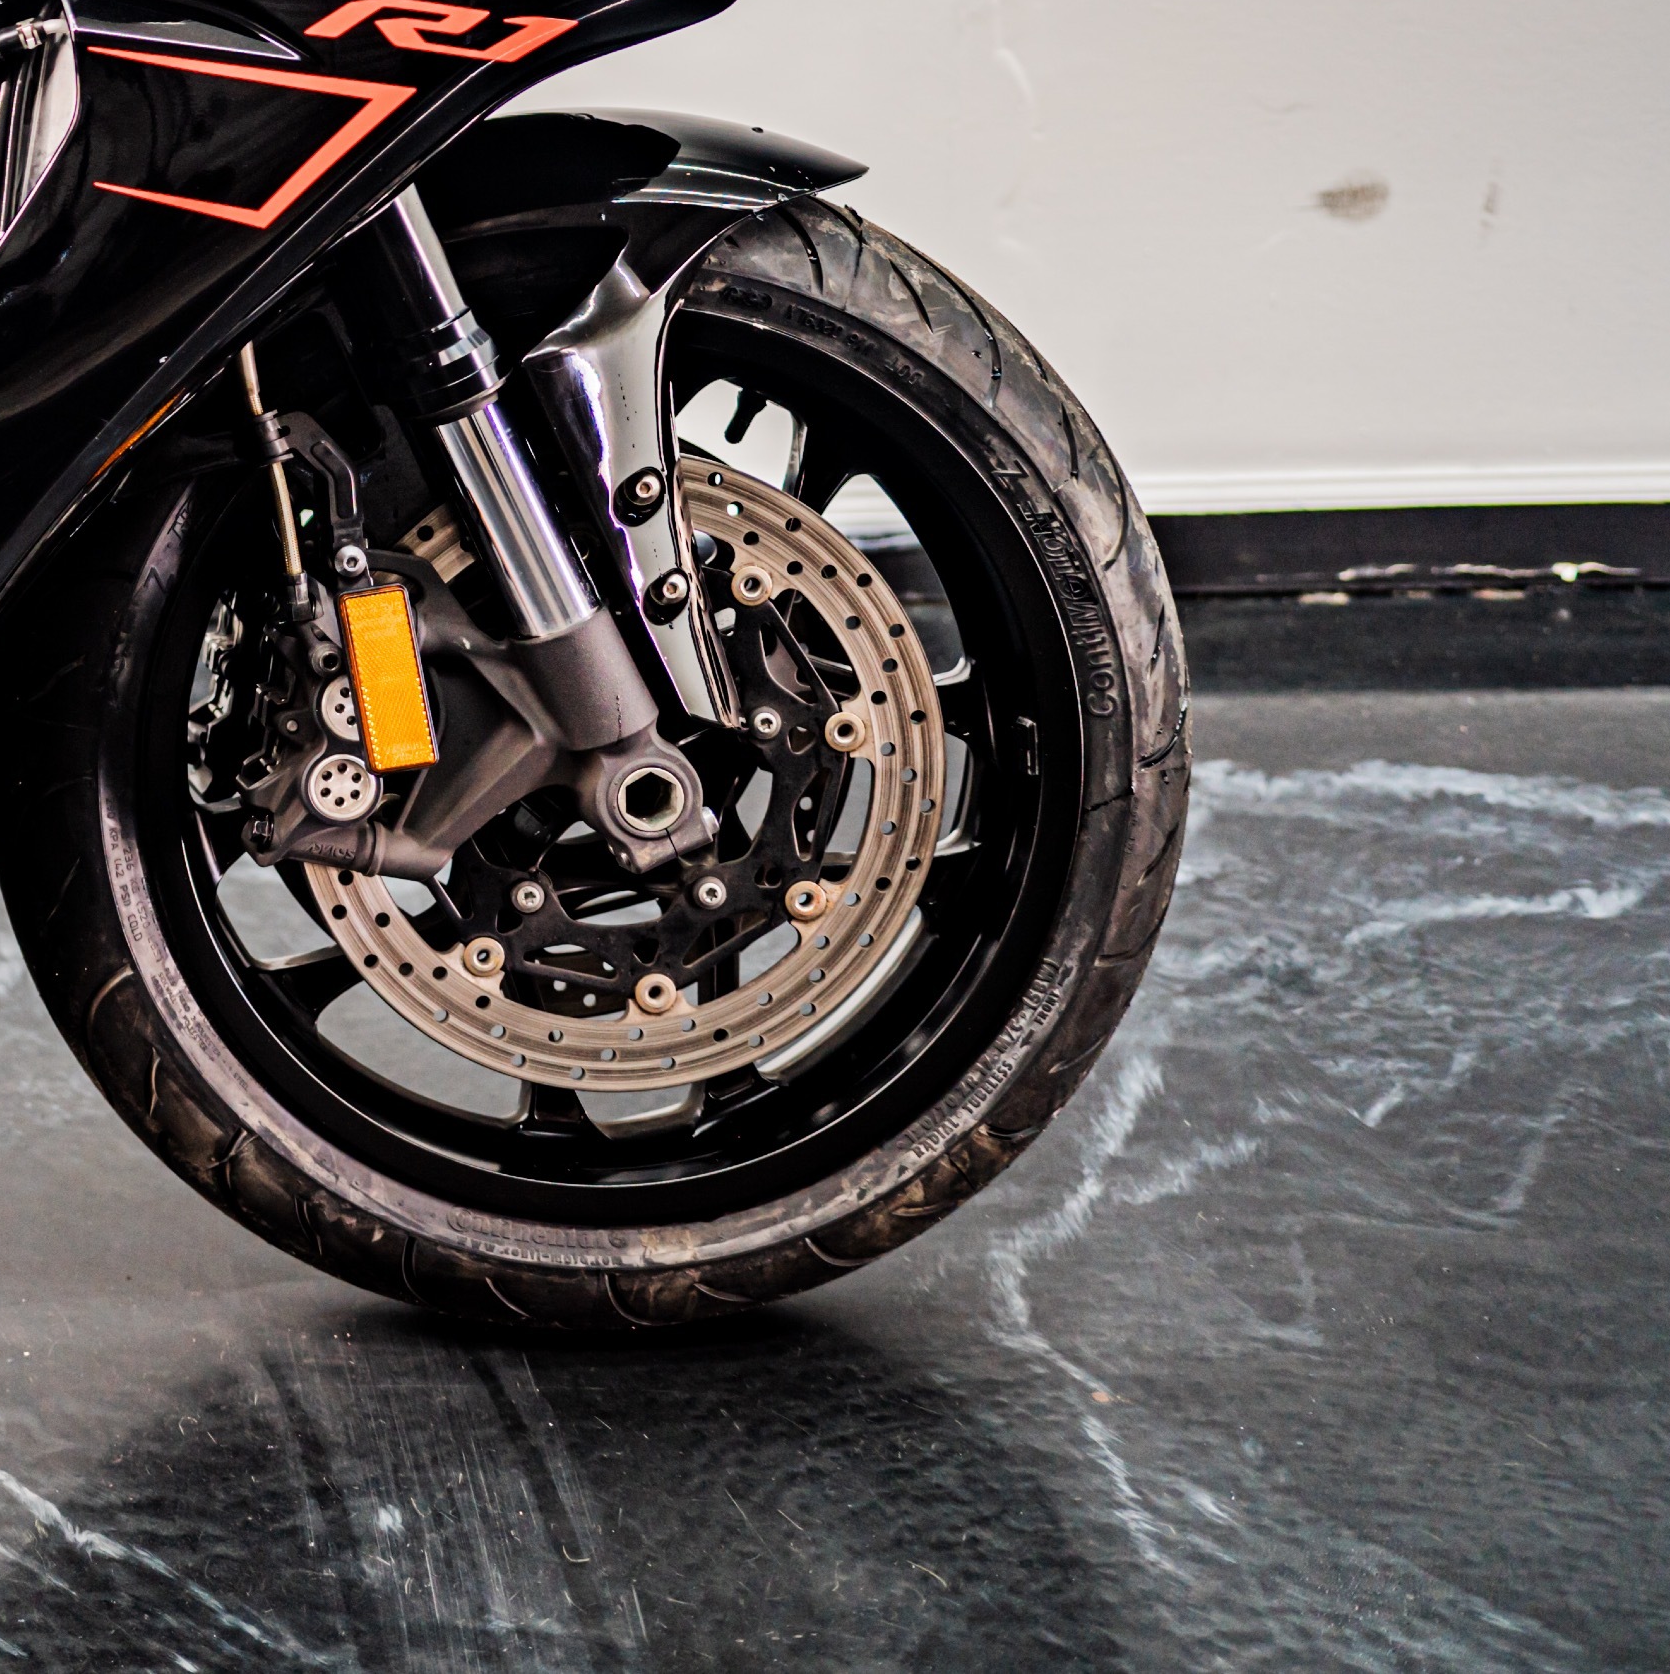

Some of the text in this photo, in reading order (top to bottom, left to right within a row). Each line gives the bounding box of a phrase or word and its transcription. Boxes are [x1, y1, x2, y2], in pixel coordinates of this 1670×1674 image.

[990, 457, 1029, 491] Z
[107, 827, 120, 850] KPA
[112, 857, 125, 878] (42
[121, 846, 135, 871] 236
[127, 914, 143, 942] COLD
[912, 991, 1059, 1159] RADIAL TUBELESS FRONT
